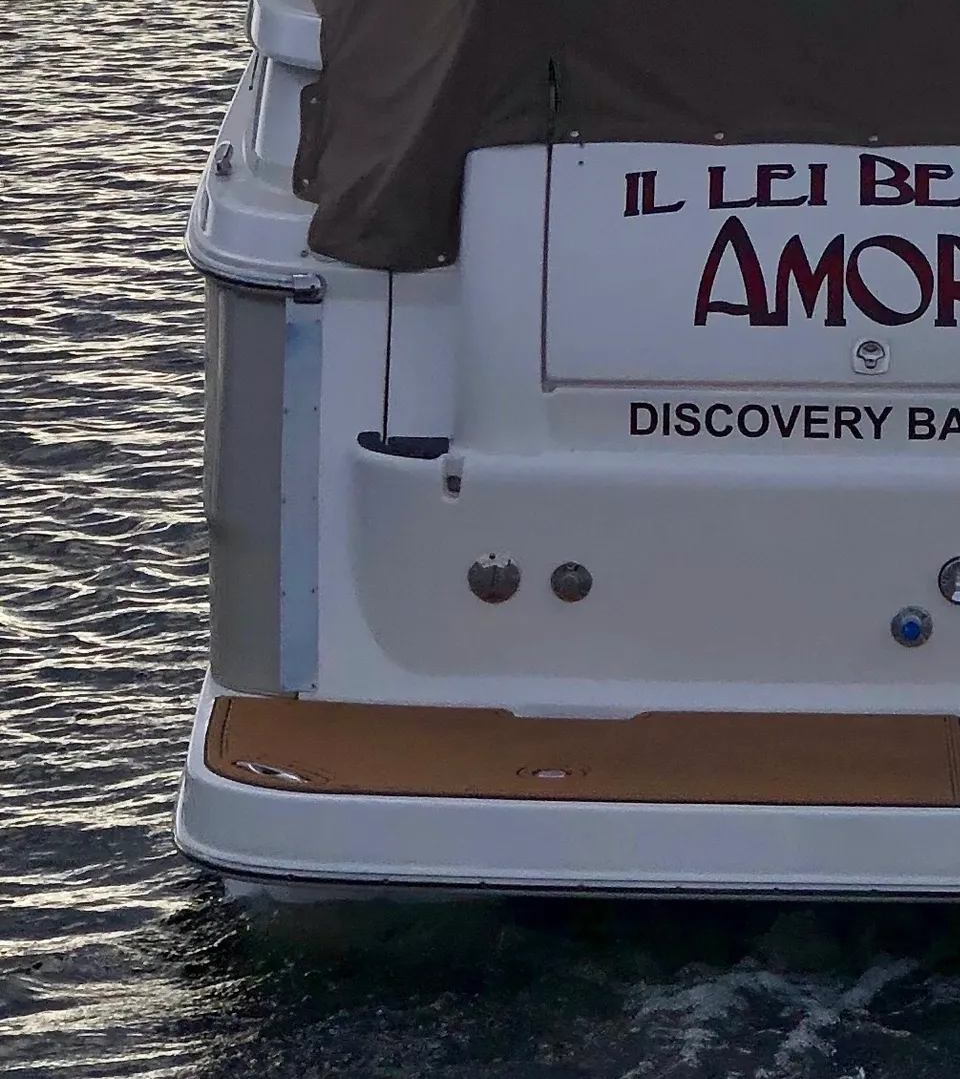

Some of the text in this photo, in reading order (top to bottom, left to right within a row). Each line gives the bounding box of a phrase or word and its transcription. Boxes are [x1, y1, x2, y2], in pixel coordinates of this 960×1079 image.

[624, 170, 686, 217] IL
[708, 163, 828, 209] LEI
[629, 402, 893, 440] DISCOVERY
